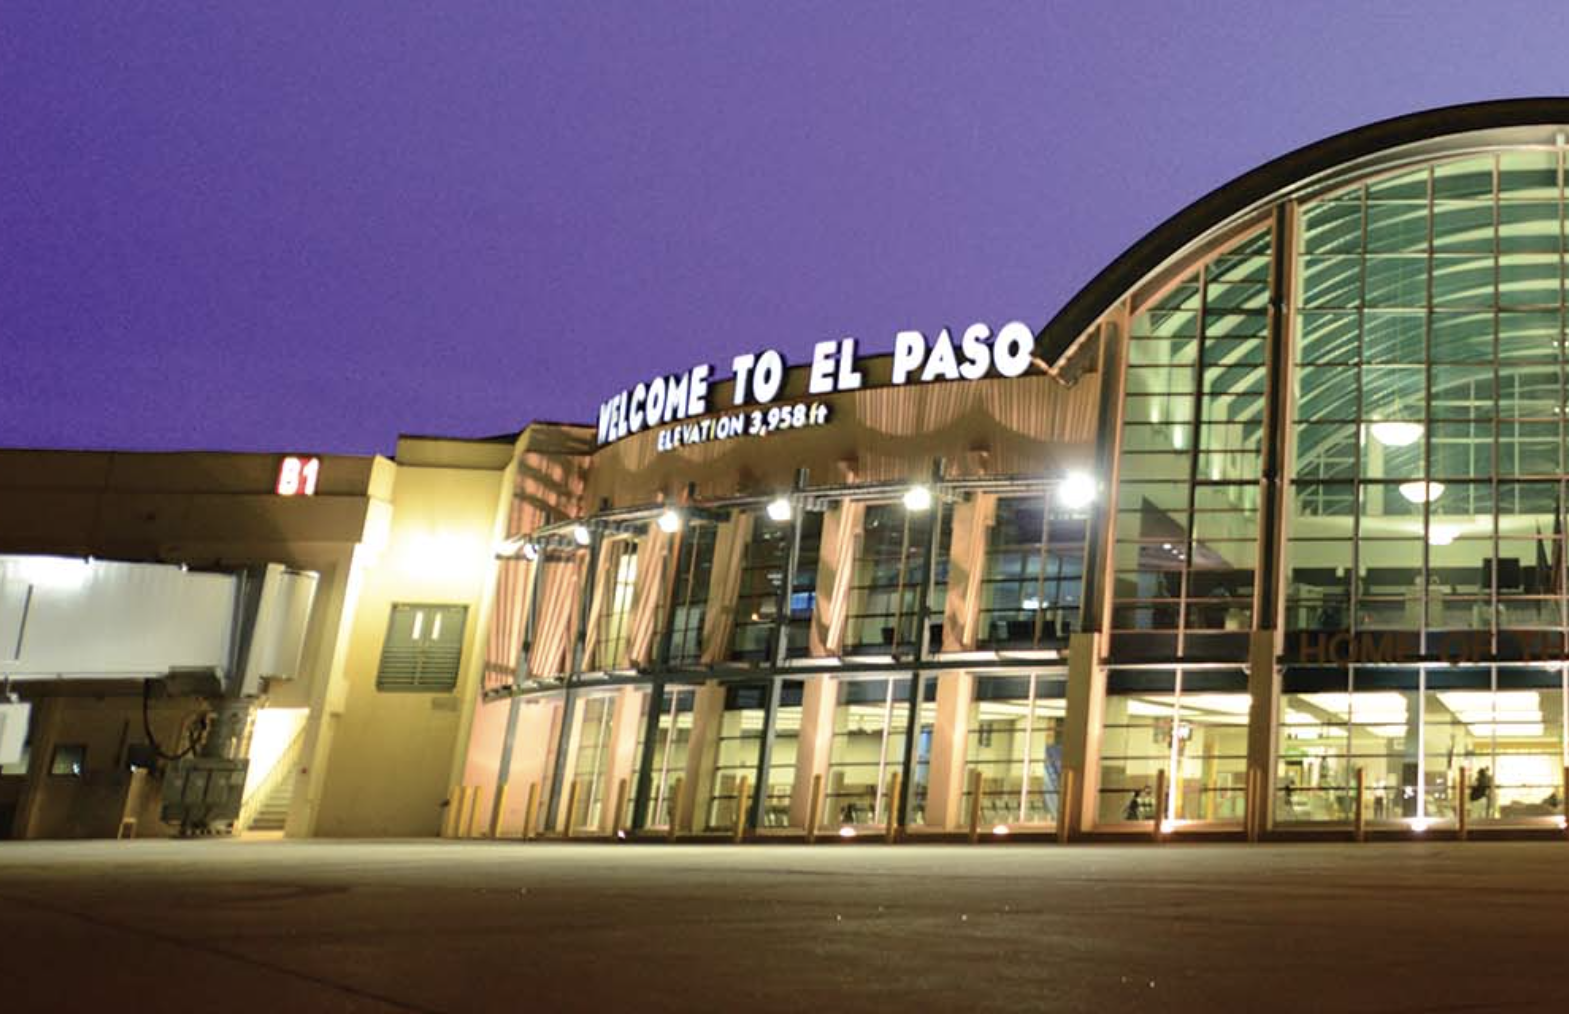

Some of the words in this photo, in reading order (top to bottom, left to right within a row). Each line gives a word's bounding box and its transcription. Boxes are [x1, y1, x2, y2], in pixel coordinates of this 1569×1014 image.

[598, 364, 709, 446] WELCOME
[732, 349, 784, 405] TO
[809, 337, 863, 394] EL
[892, 321, 1035, 385] PASO
[657, 411, 746, 452] ELEVATION
[749, 402, 807, 437] 3,958
[808, 401, 828, 425] ft
[1299, 631, 1417, 667] HOME
